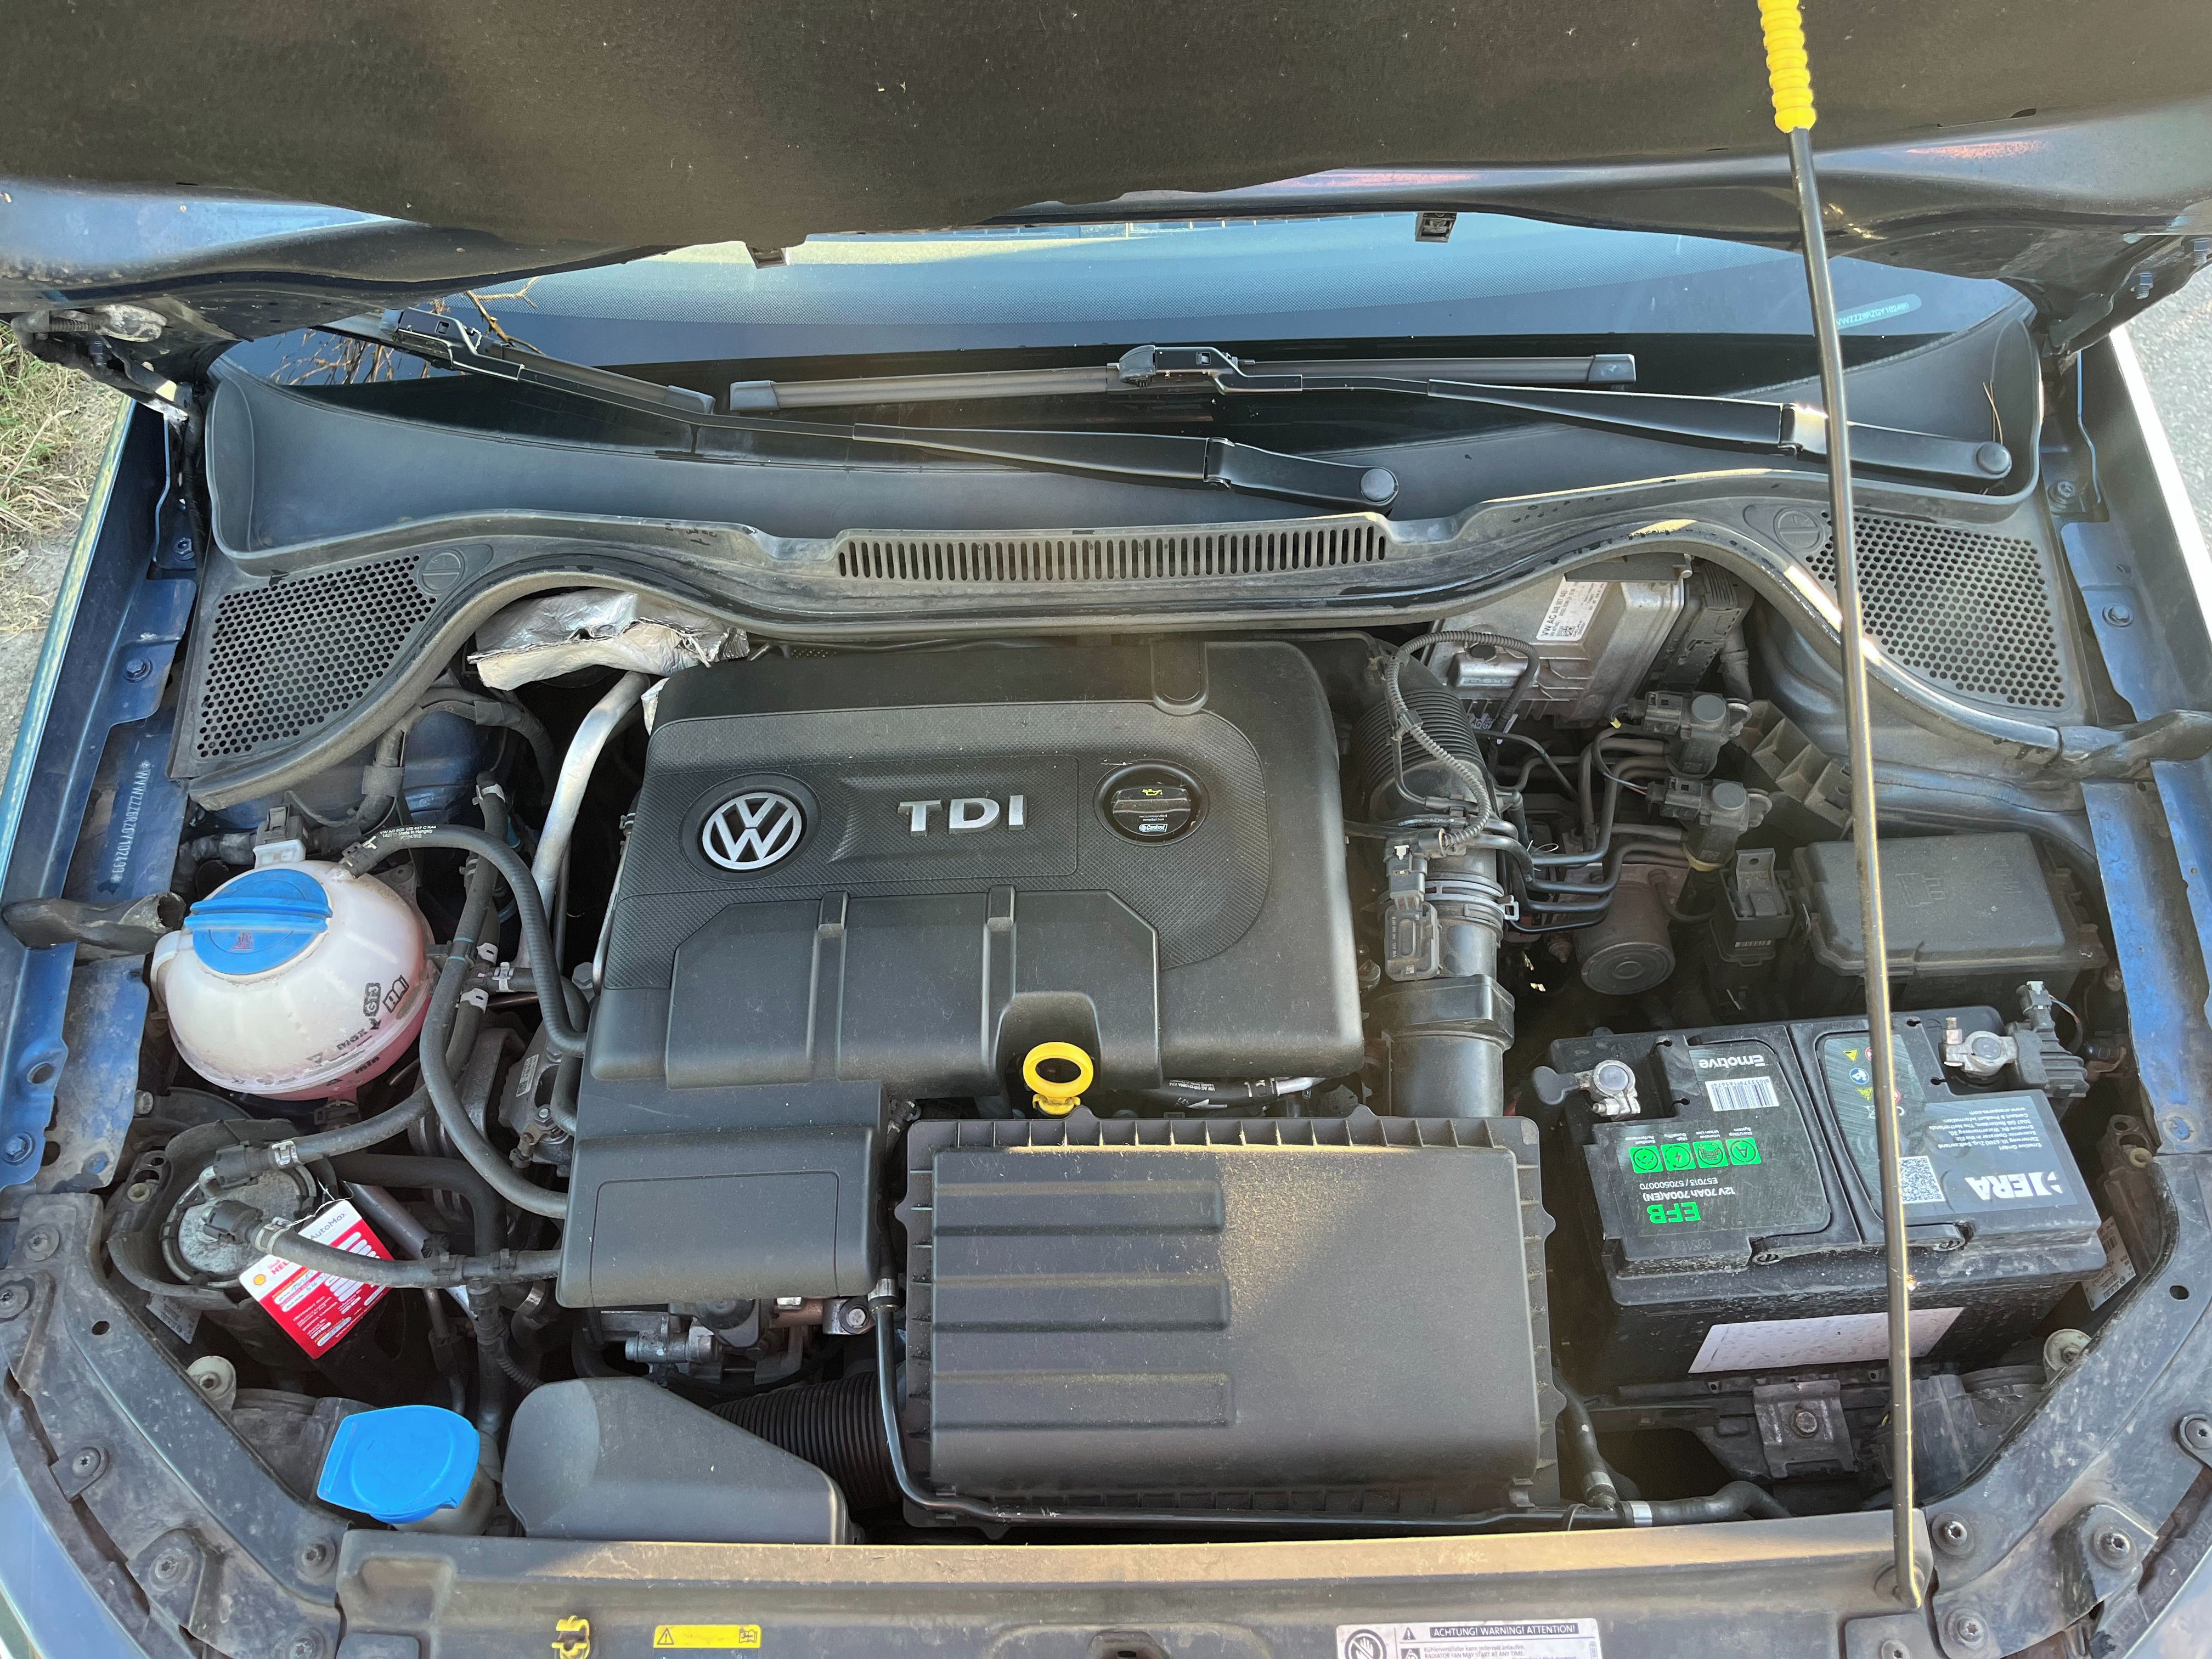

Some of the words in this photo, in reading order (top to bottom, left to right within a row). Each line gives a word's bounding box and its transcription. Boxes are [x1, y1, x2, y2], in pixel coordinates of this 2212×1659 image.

[1541, 625, 1551, 636] VW
[1547, 615, 1557, 624] AG
[898, 794, 1027, 836] TDI
[364, 985, 379, 1012] G13
[337, 1029, 367, 1050] max
[356, 1057, 380, 1074] min
[1699, 1054, 1765, 1069] Emotive
[1639, 1180, 1683, 1189] 570500070
[1689, 1177, 1717, 1186] E57013
[1643, 1189, 1688, 1201] 700A(EN)
[1690, 1188, 1715, 1197] 70Ah
[1718, 1186, 1735, 1195] 12V
[1646, 1201, 1701, 1224] EFB
[268, 1259, 281, 1270] Shell
[271, 1260, 290, 1274] HEL
[1434, 1627, 1478, 1637] ACHTUNG!
[1480, 1625, 1525, 1636] WARNING!
[1527, 1623, 1576, 1634] ATTENTION!
